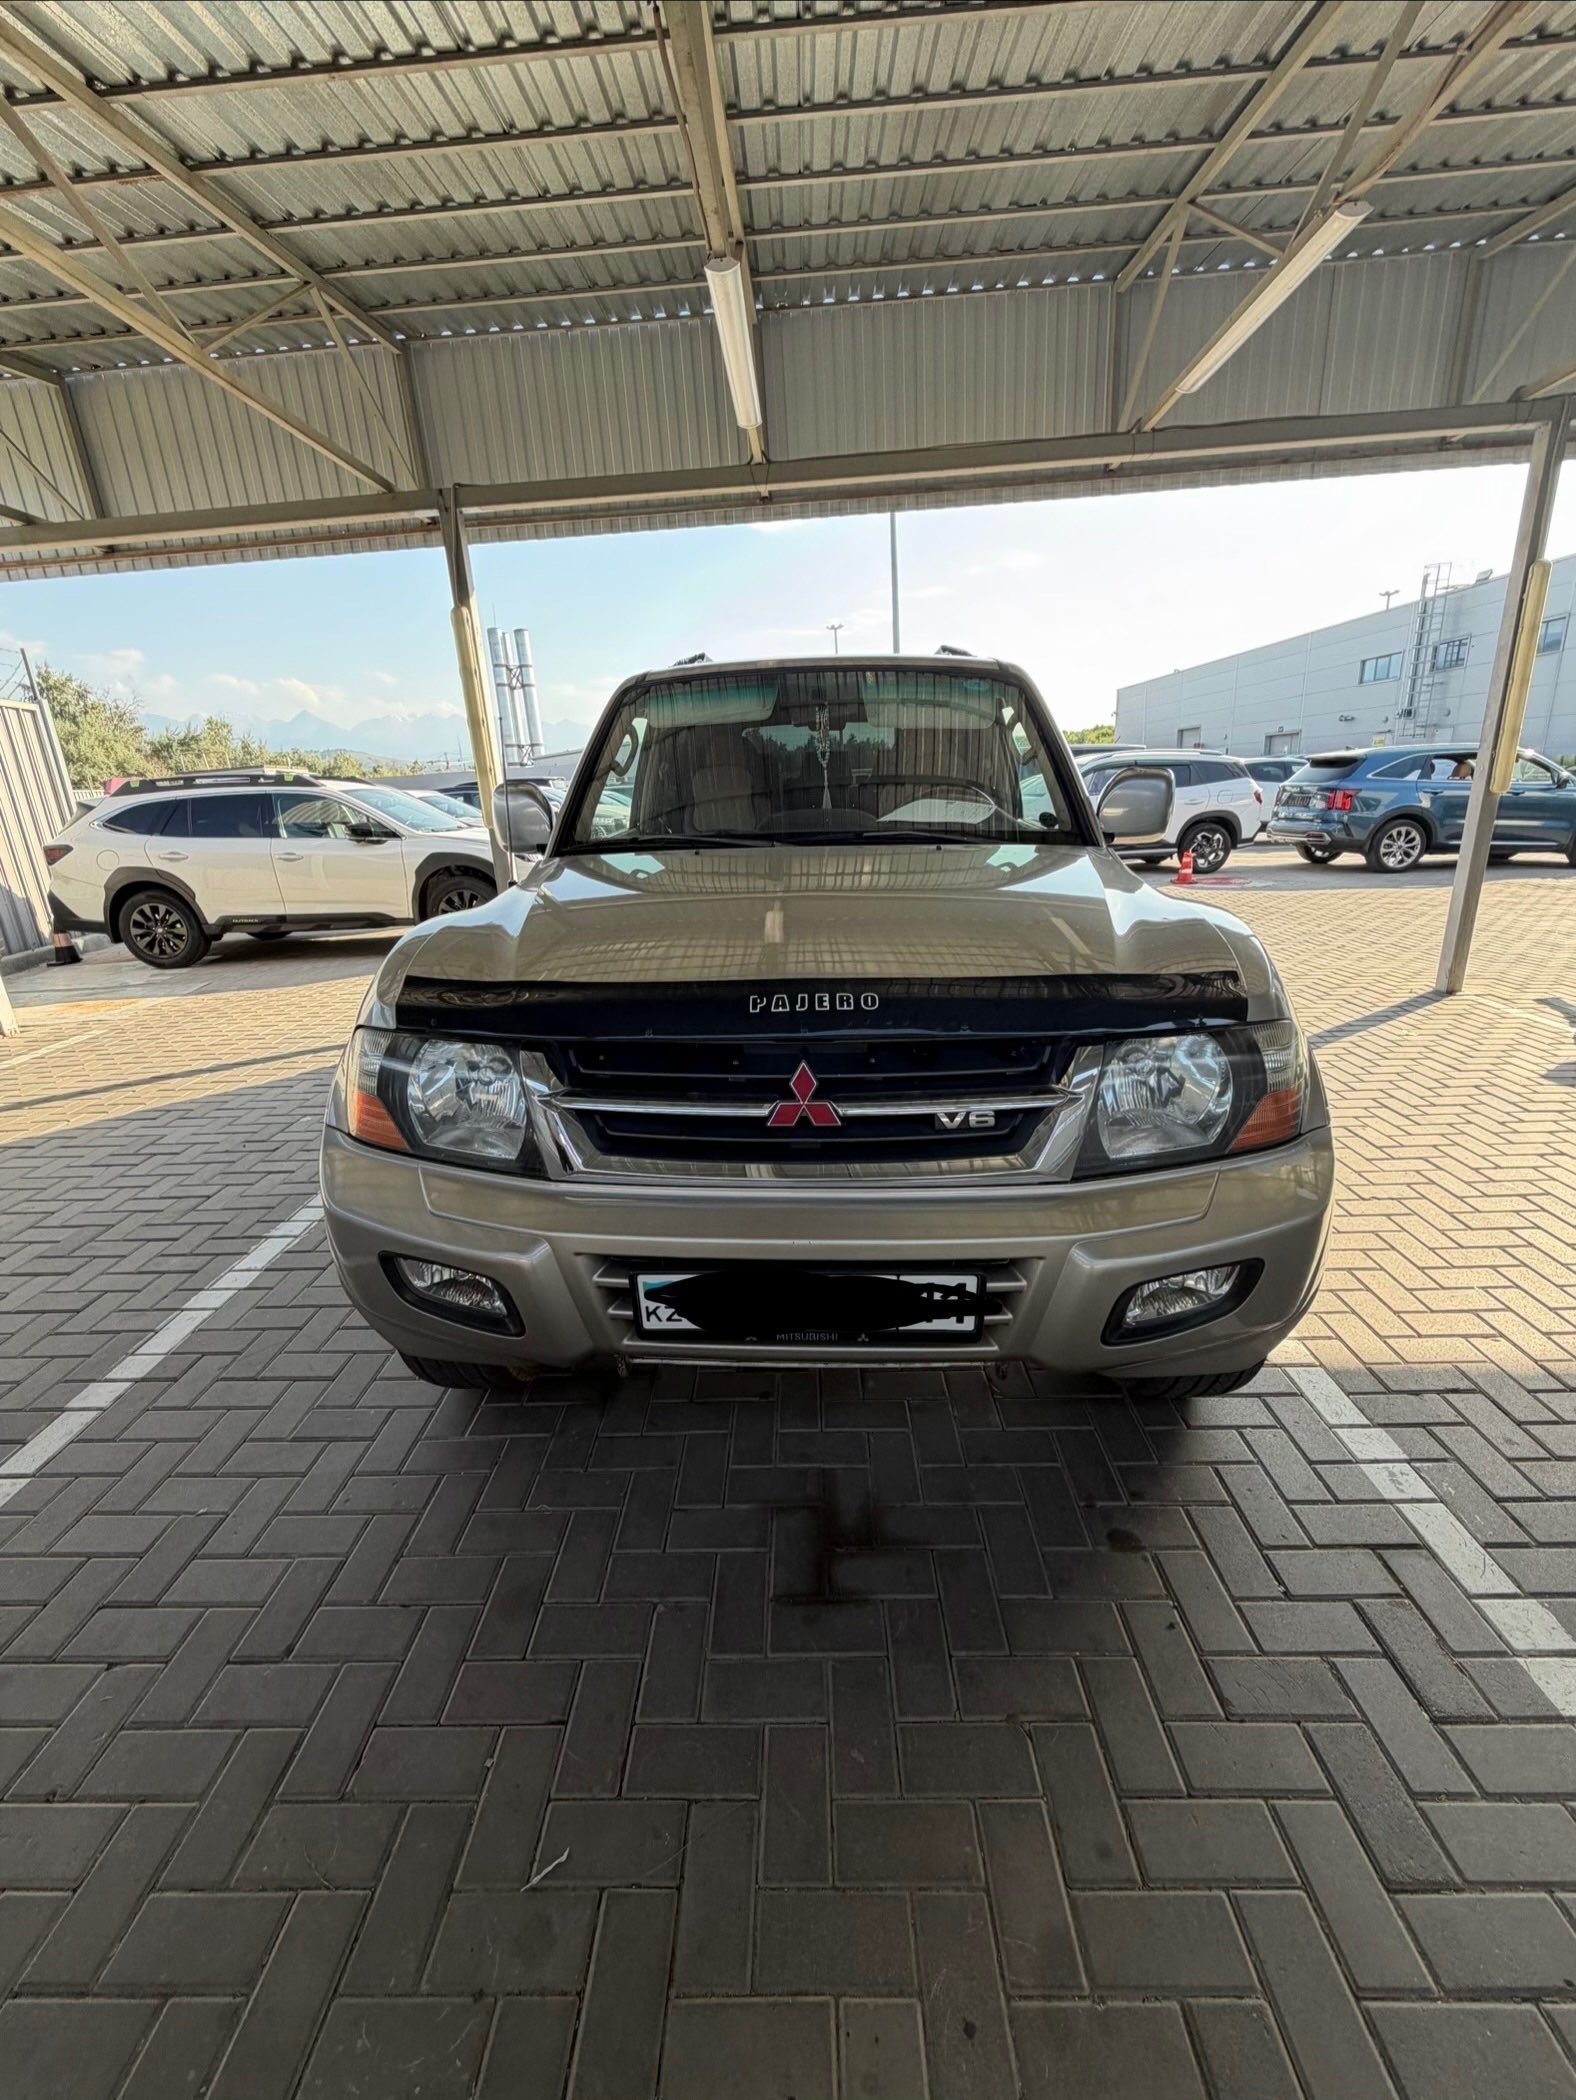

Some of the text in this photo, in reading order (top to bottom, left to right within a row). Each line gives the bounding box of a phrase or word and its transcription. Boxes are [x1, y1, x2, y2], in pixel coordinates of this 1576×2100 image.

[749, 992, 879, 1013] PAJERO
[936, 1110, 996, 1130] V6
[645, 1305, 683, 1323] KZ
[776, 1331, 839, 1342] MITSUBISHI
